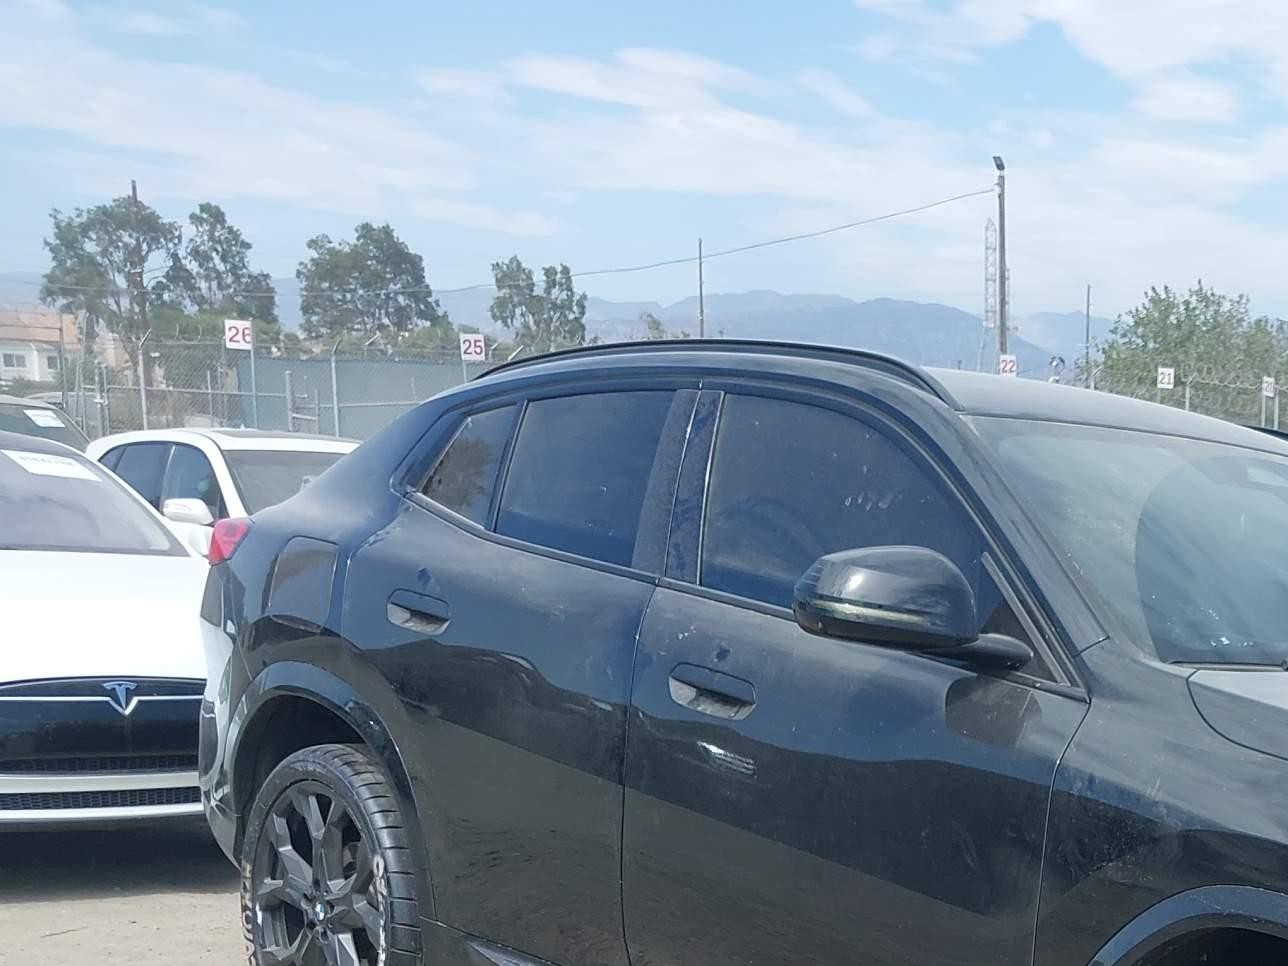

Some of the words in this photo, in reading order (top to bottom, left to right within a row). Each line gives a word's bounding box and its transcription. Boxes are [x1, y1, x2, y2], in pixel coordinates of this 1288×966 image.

[228, 326, 252, 344] 26
[462, 339, 484, 355] 25
[1001, 359, 1016, 374] 22
[1159, 371, 1173, 386] 21
